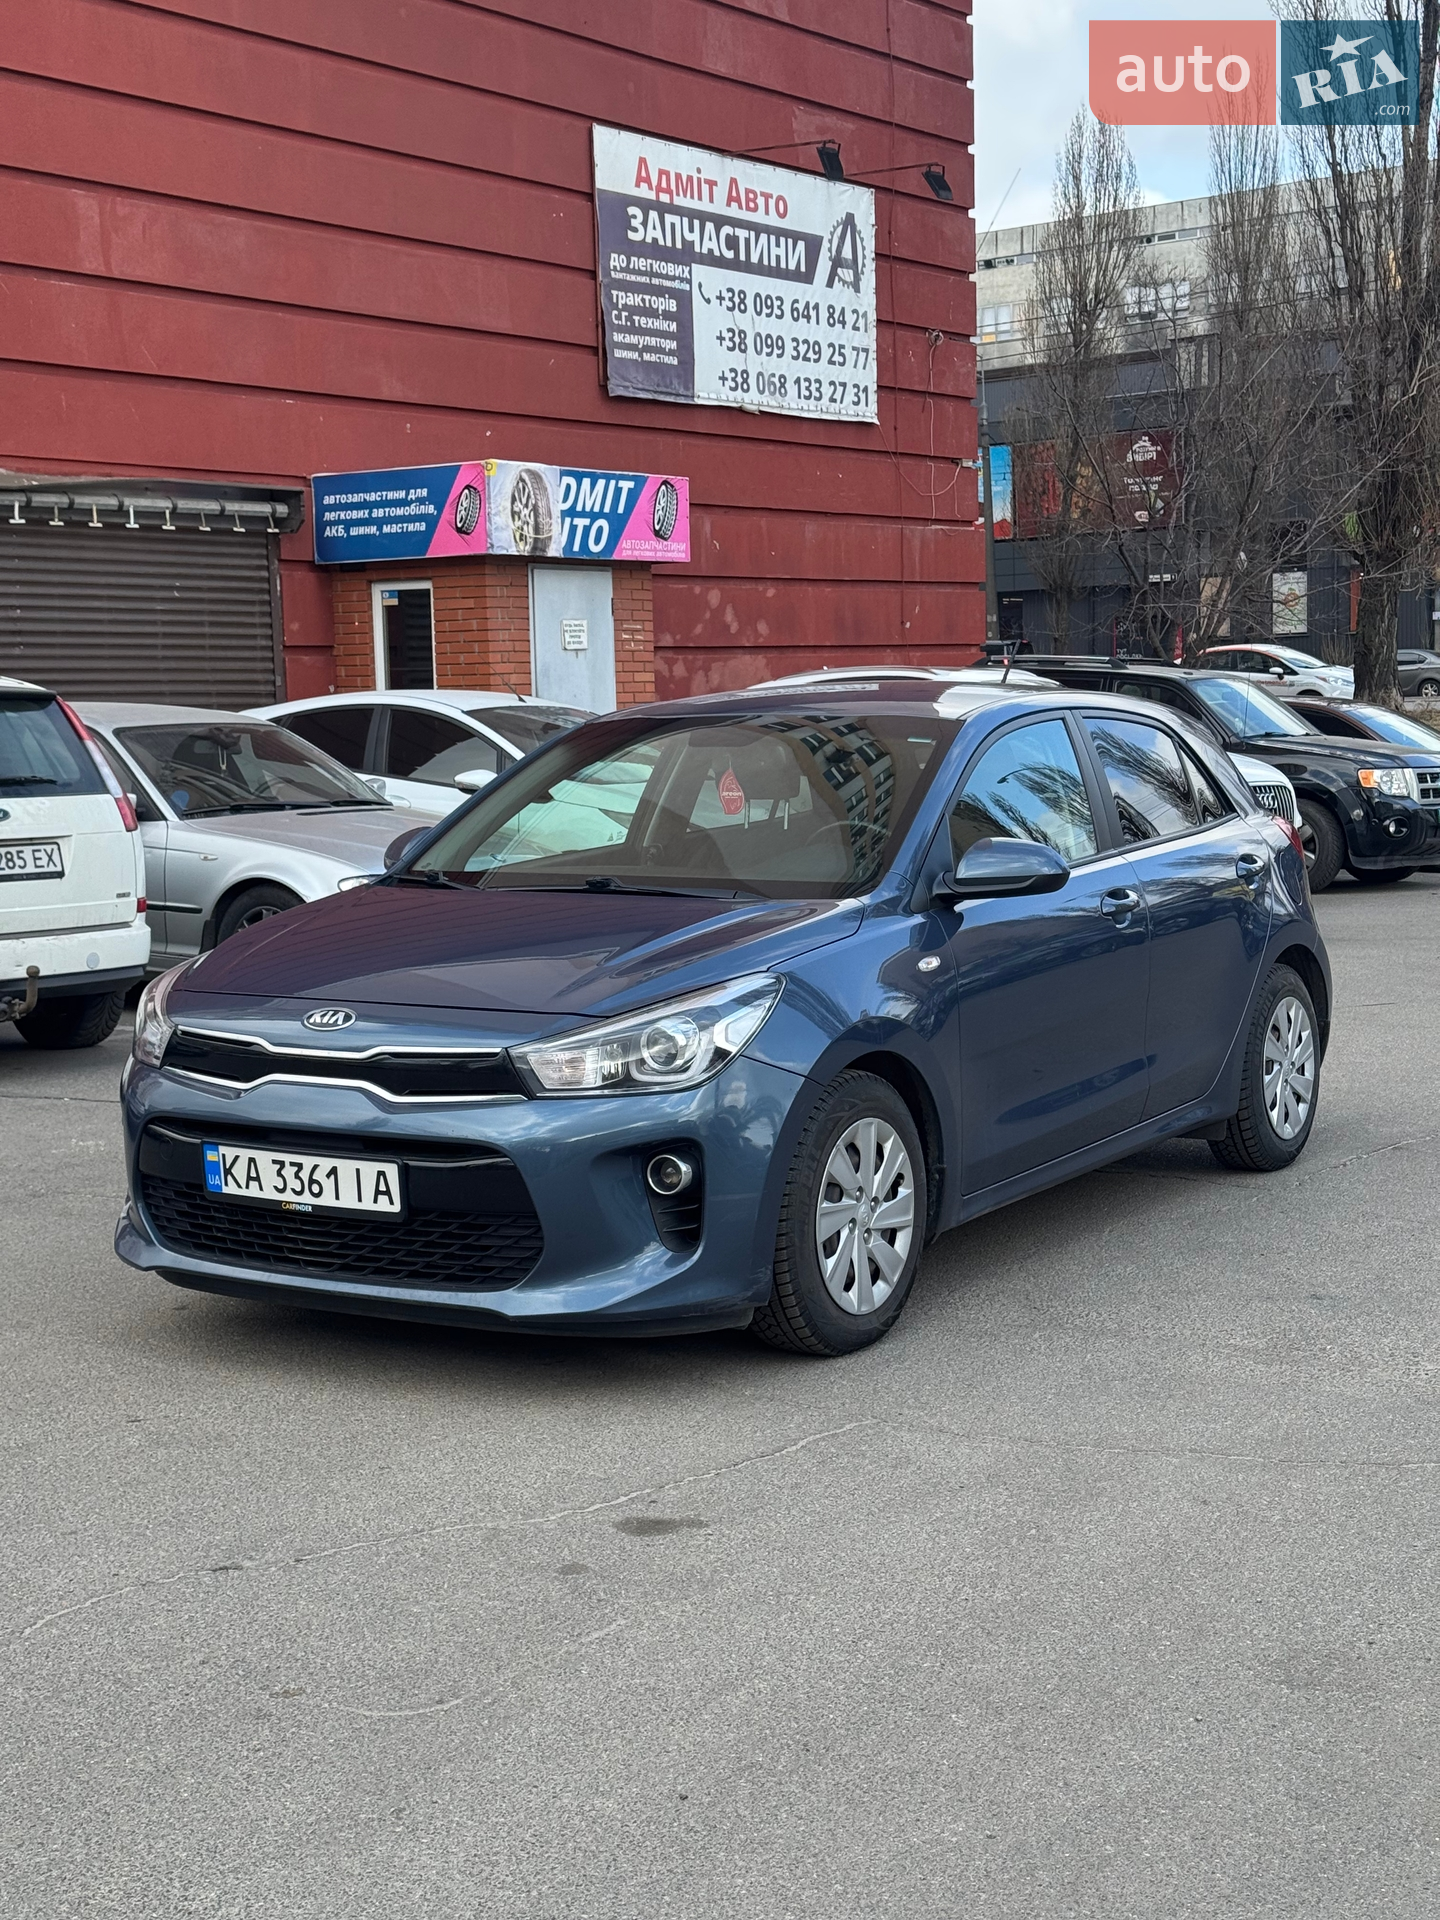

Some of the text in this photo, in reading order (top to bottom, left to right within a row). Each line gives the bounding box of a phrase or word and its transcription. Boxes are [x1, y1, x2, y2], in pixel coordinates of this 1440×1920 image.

[634, 156, 788, 219] Адміт Авто
[626, 206, 806, 272] ЗАПЧАСТИНИ
[610, 252, 690, 279] до легкових
[611, 289, 677, 314] тракторів
[716, 287, 868, 334] +38 093 641 84 21
[612, 310, 677, 332] С.Г. техніки
[613, 332, 677, 352] акамулятори
[716, 327, 870, 370] +38 099 329 25 77
[614, 348, 678, 366] шини, мастила
[718, 367, 869, 408] +38 068 133 27 31
[322, 488, 428, 506] автозапчастини для
[323, 503, 438, 522] легкових автомобілів,
[324, 522, 426, 538] АКБ, шини, мастила
[622, 540, 686, 552] АВТОЗАПЧАСТИНИ
[32, 848, 58, 869] EX
[308, 1010, 346, 1025] KIA
[208, 1174, 221, 1186] UA
[222, 1152, 395, 1206] KA 3361 IA
[282, 1202, 312, 1212] CARFINDER
